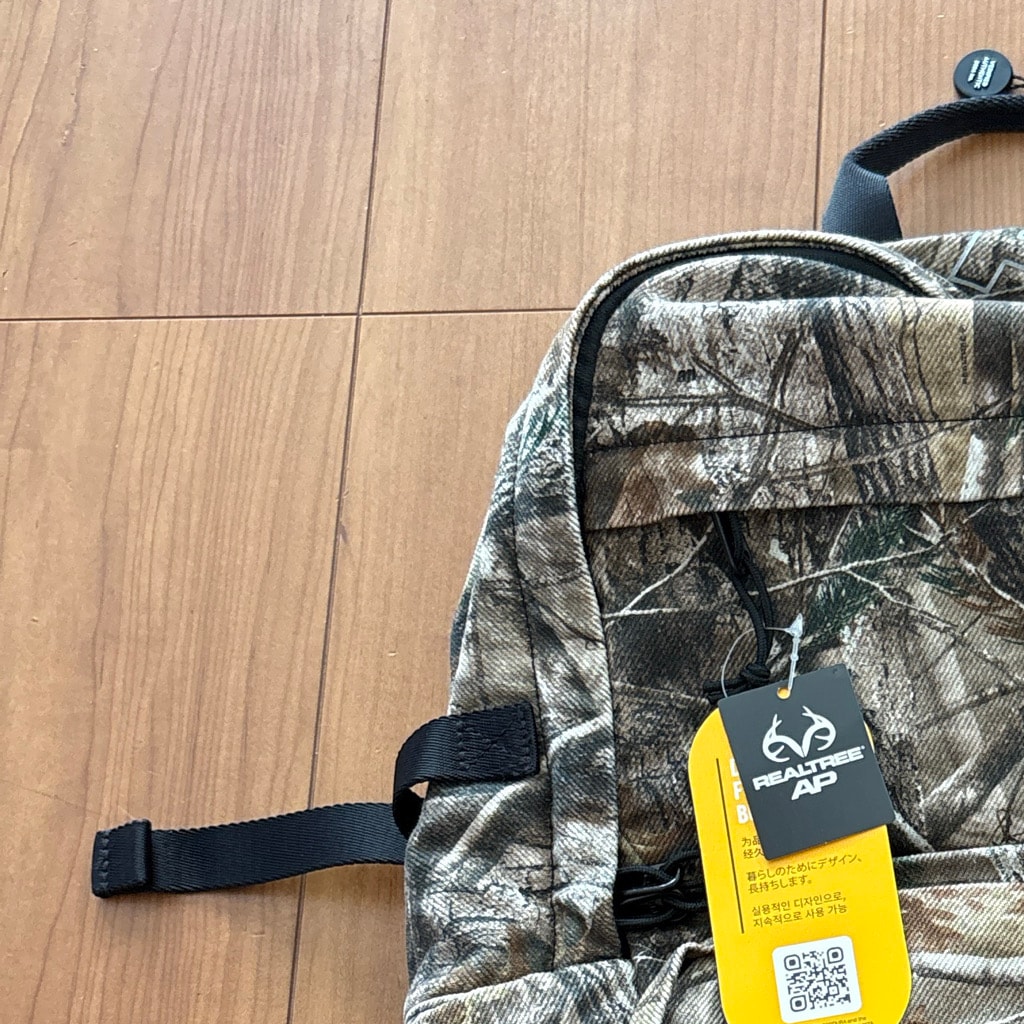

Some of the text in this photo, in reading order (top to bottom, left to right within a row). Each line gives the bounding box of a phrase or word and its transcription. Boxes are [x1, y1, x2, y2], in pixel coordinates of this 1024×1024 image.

[791, 771, 838, 801] AP
[752, 891, 846, 916] 실용적인 디자인으로,
[753, 904, 847, 927] 지속적으로 사용 가능
